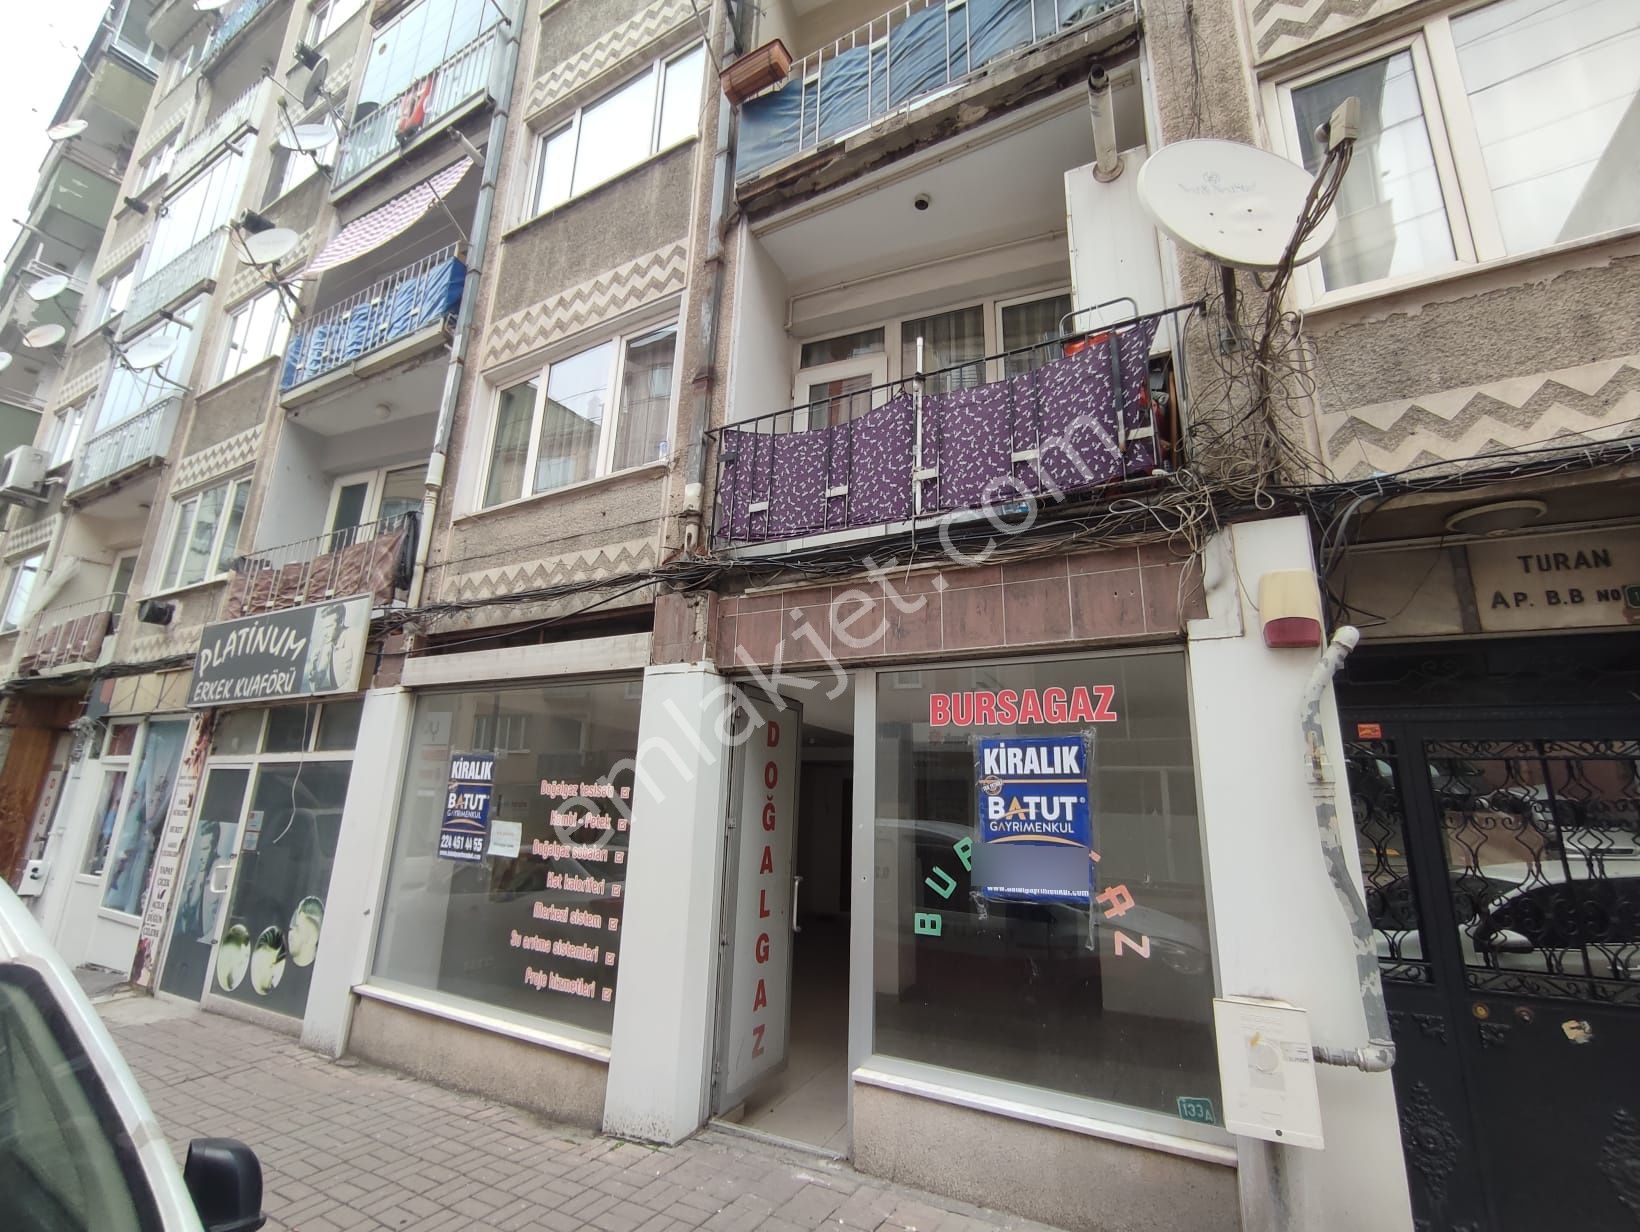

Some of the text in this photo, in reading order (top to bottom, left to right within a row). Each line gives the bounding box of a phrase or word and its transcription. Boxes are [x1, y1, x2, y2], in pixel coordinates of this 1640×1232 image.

[1517, 549, 1612, 573] TURAN
[1491, 590, 1535, 609] AP.
[1596, 589, 1622, 602] NO
[199, 620, 307, 679] PLATİNUM
[193, 667, 297, 702] ERKEK KUAFÖRÜ
[929, 685, 1118, 727] BURSAGAZ
[451, 757, 493, 780] KİRALIK
[984, 743, 1081, 775] KİRALIK
[447, 793, 487, 811] BATUT
[540, 779, 579, 800] Doğalgaz
[585, 812, 612, 830] Petek
[988, 796, 1078, 821] BATUT
[532, 838, 570, 861] Doğalgaz
[564, 873, 605, 895] kaloriferi
[752, 720, 781, 1059] DOĞALGAZ
[532, 901, 602, 929] Merkezi sistem
[552, 938, 599, 964] sistemleri
[524, 966, 597, 999] Proje hizmetleri
